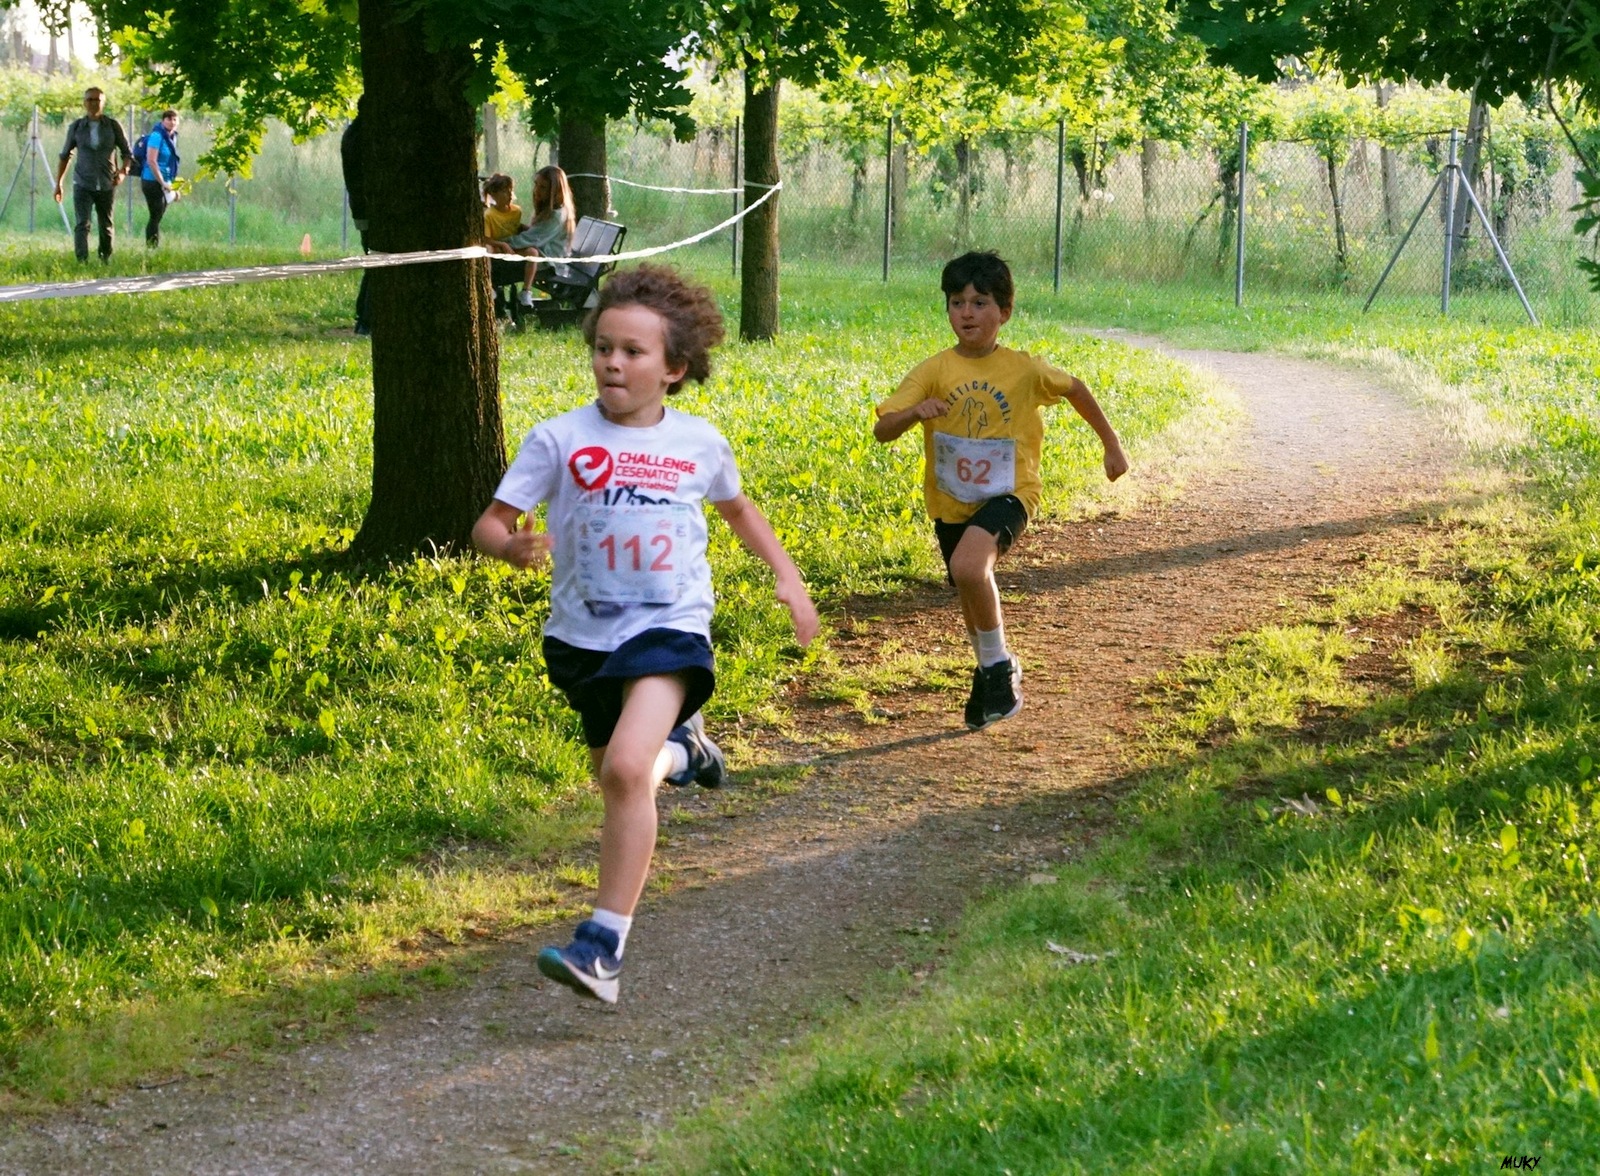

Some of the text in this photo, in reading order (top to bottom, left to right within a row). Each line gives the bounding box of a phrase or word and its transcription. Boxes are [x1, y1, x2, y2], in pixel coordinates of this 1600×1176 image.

[943, 380, 1011, 424] LETICAIMOLA
[614, 465, 680, 483] CESENATICO
[618, 452, 696, 474] CHALLENGE
[957, 457, 991, 485] 62
[598, 534, 673, 572] 112
